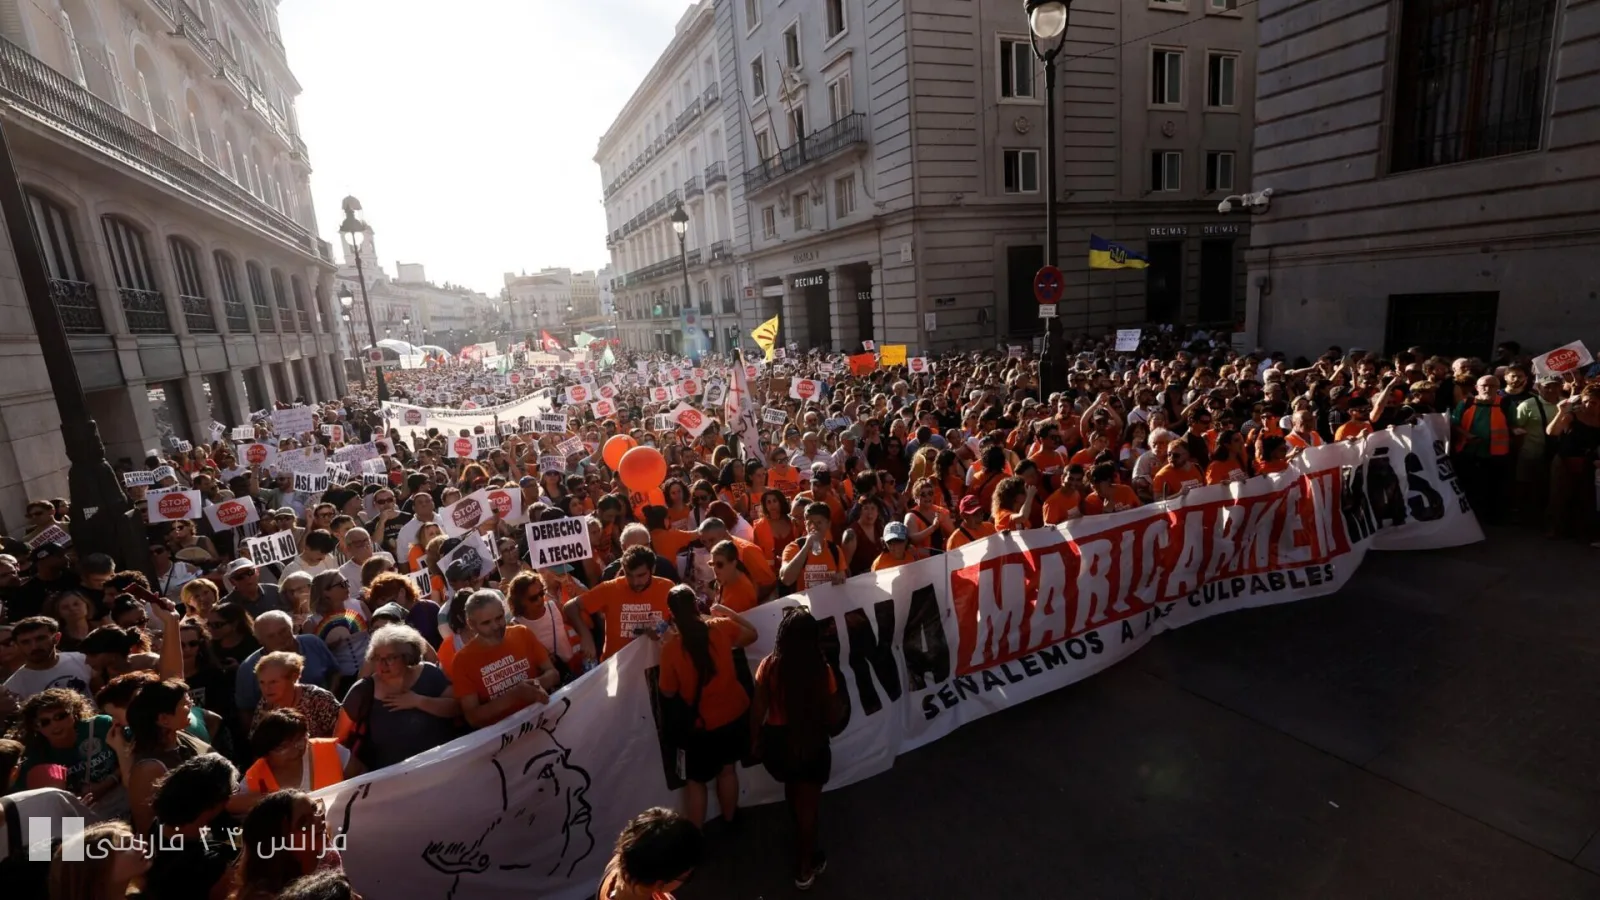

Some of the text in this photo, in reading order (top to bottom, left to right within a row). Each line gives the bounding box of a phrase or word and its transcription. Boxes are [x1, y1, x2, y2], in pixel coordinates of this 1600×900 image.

[1150, 228, 1187, 236] DECIMAS
[795, 275, 823, 288] DECIMAS
[858, 292, 872, 300] DEC
[1548, 351, 1573, 366] STOP
[315, 475, 327, 489] NO
[337, 471, 348, 486] NO
[493, 496, 510, 505] TOP
[219, 506, 243, 517] STOP
[454, 501, 478, 519] STOP
[532, 519, 582, 541] DERECHO
[278, 534, 296, 558] NO
[540, 542, 587, 565] A TECHO.
[970, 473, 1338, 667] MARICARMEN
[1341, 447, 1445, 544] MÁS
[622, 603, 651, 611] SINDICATO
[621, 613, 629, 621] DE
[921, 631, 1104, 720] SEÑALEMOS
[1121, 619, 1134, 643] A
[1187, 564, 1335, 607] CULPABLES
[481, 655, 514, 676] SINDICATO
[484, 660, 528, 685] DE INQUILINAS
[493, 671, 529, 693] INQUILINOS
